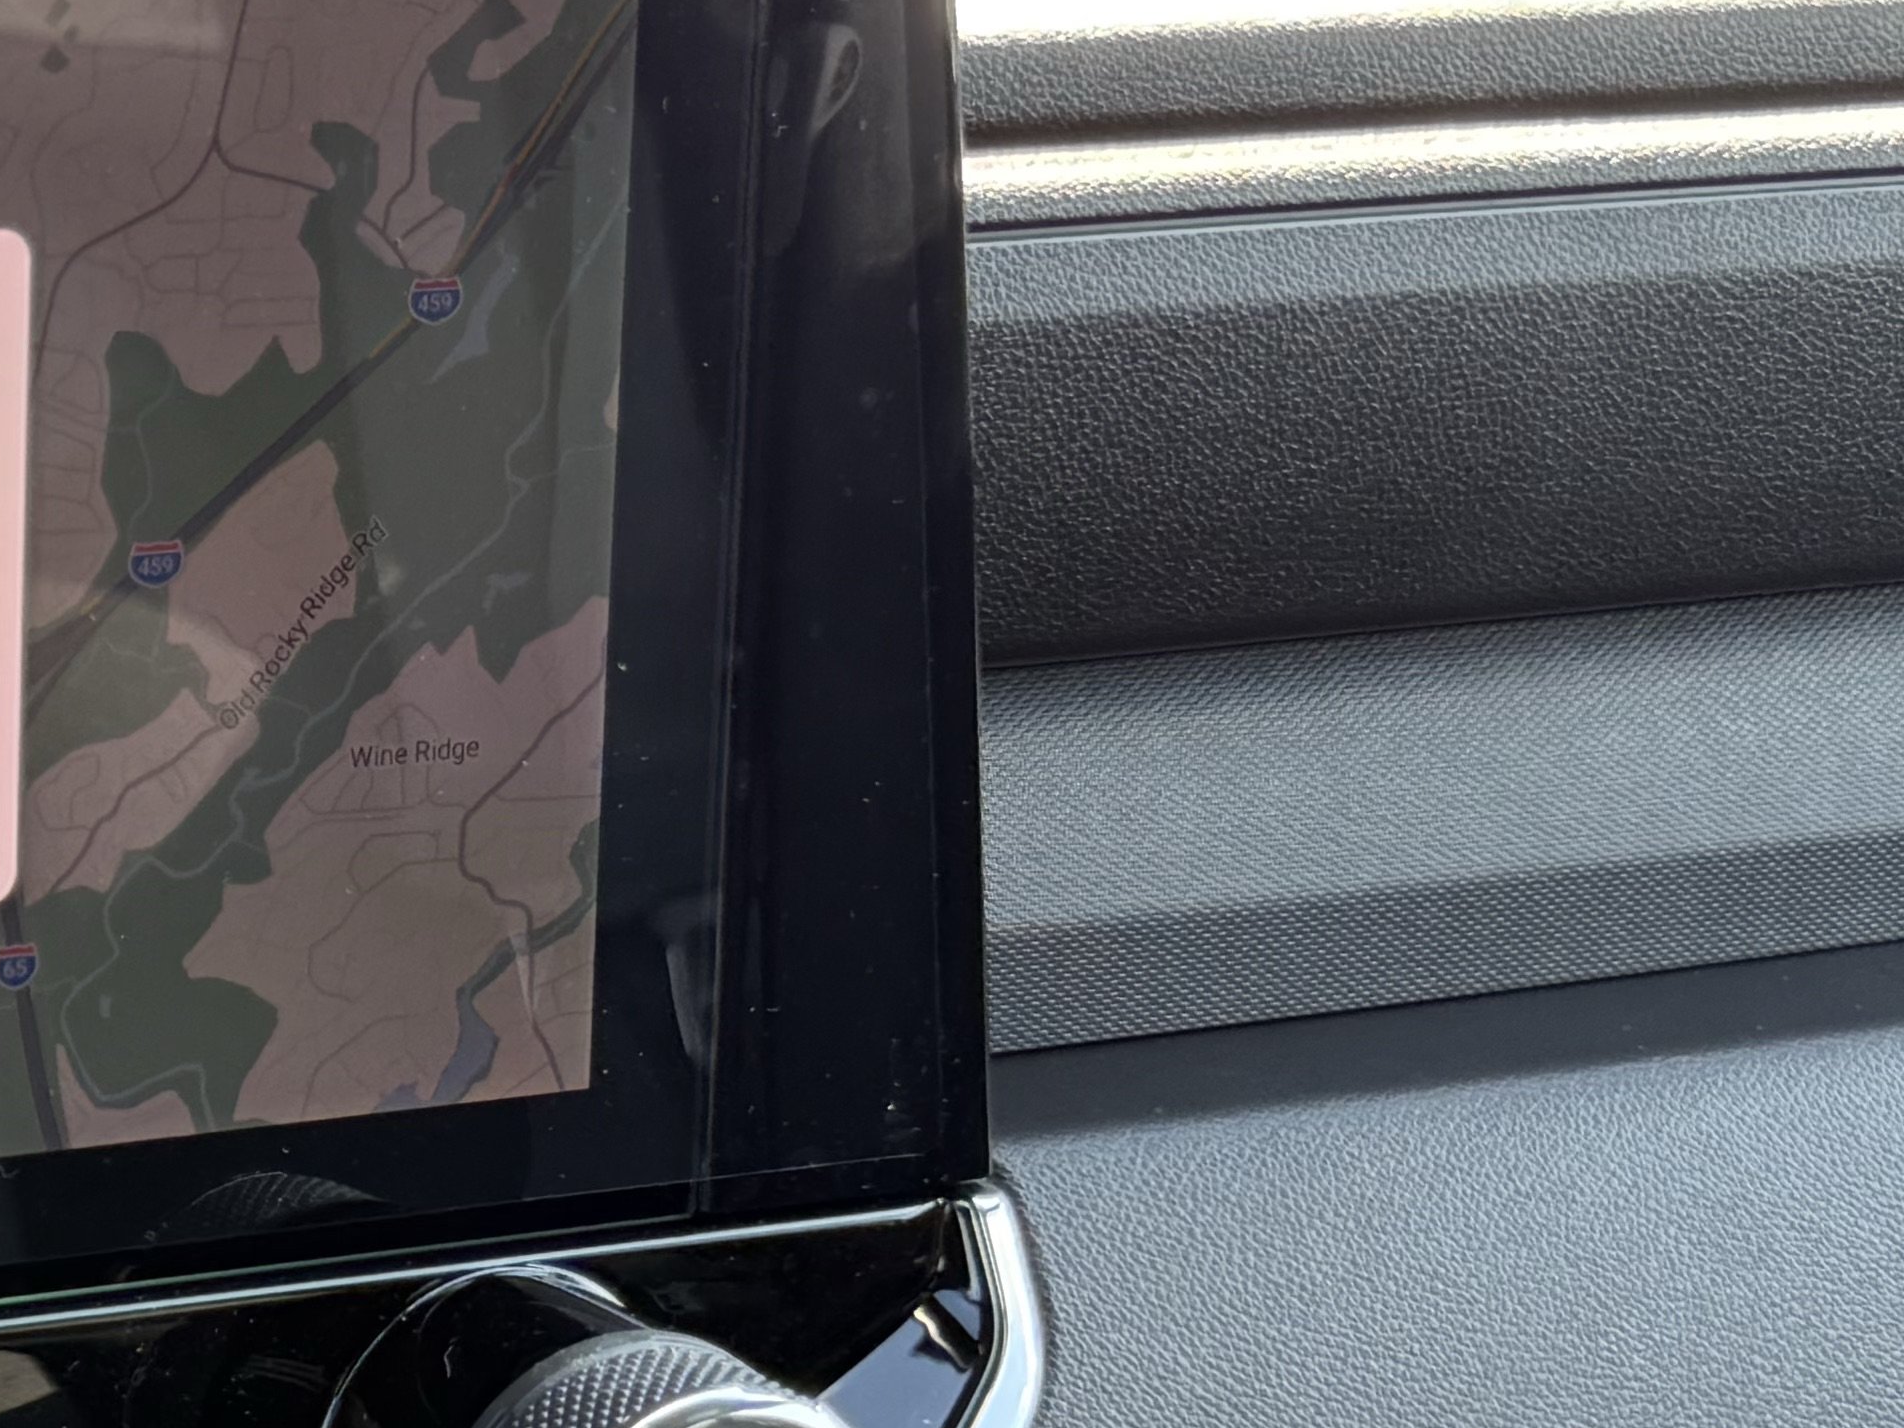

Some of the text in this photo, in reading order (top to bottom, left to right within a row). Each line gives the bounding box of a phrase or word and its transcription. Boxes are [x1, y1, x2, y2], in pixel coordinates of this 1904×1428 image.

[418, 292, 453, 313] 459
[137, 555, 174, 577] 459
[219, 519, 388, 730] Old Rocky Ridge Rd
[350, 737, 480, 768] Wine Ridge
[2, 959, 28, 978] 65
